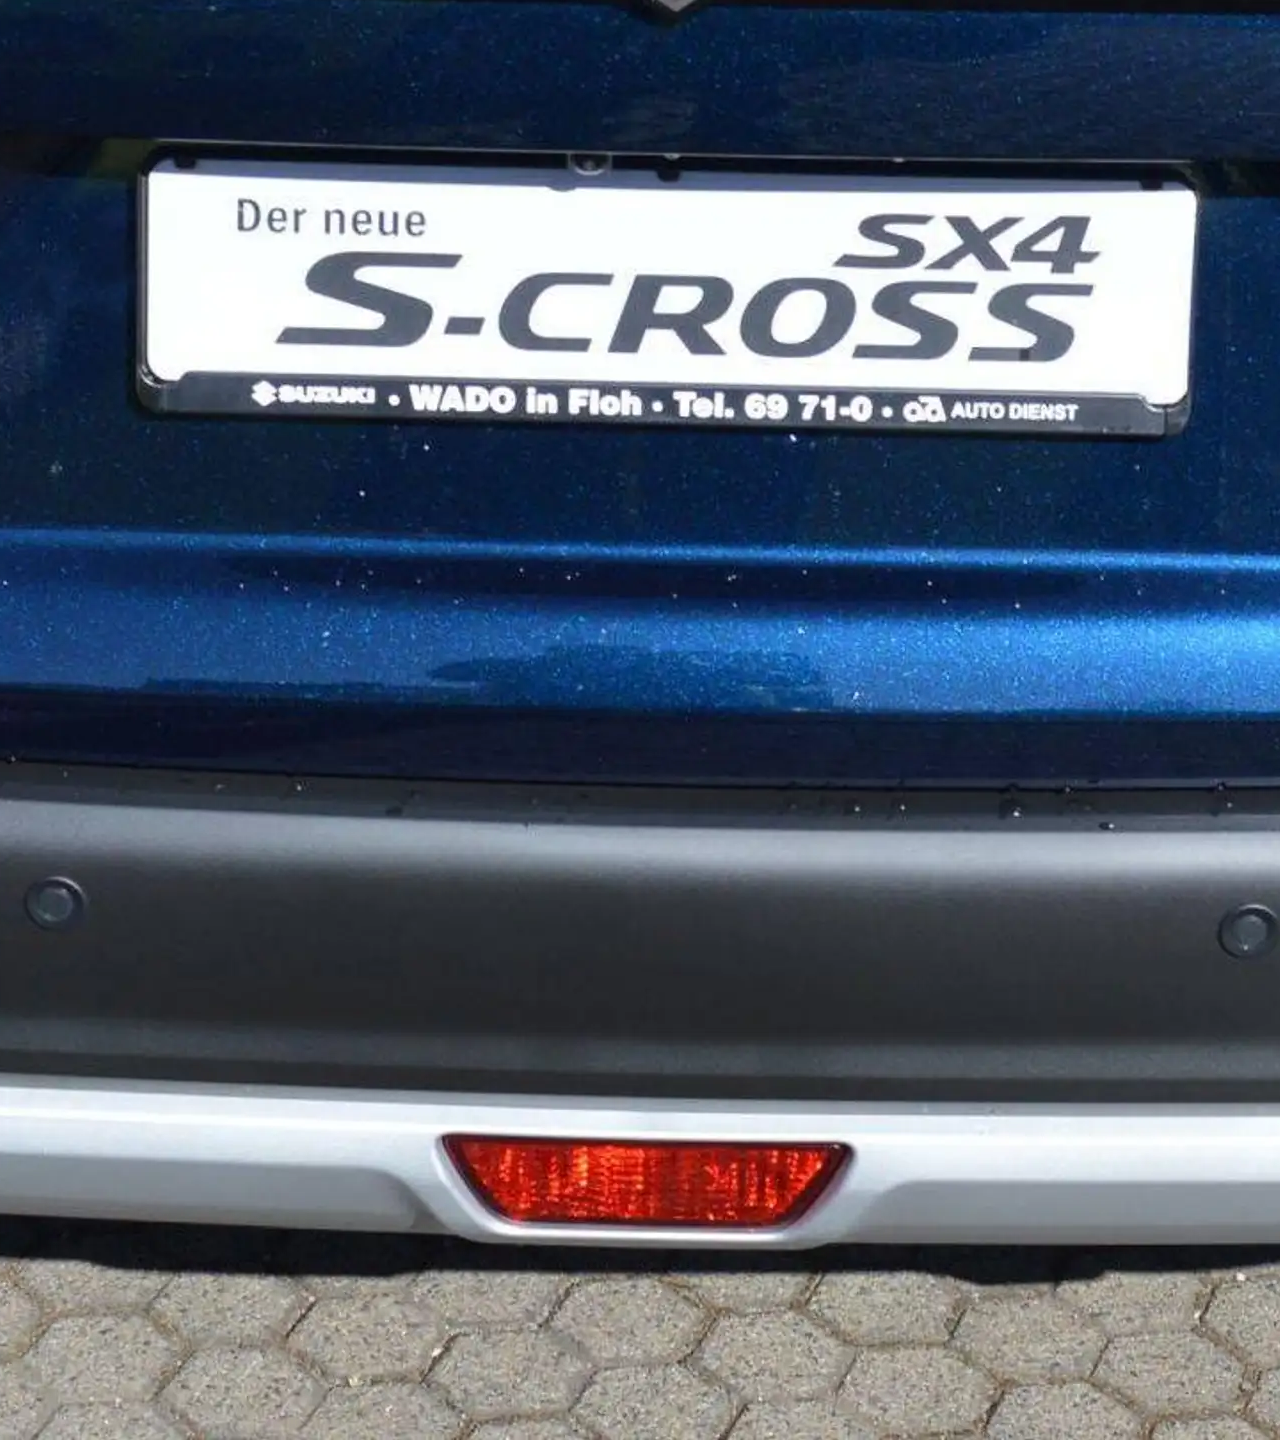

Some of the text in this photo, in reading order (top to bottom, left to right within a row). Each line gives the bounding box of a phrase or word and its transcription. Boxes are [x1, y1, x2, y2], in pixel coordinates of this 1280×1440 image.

[236, 198, 427, 237] Der neue
[833, 213, 1101, 274] SX4
[276, 250, 1095, 362] S-CROSS
[278, 384, 376, 405] SUZUKI
[409, 384, 516, 414] WADO
[526, 386, 558, 415] in
[568, 389, 643, 417] Floh
[673, 391, 735, 419] Tel.
[744, 392, 789, 420] 69
[798, 395, 873, 423] 71-0
[951, 402, 1005, 421] AUTO
[1008, 402, 1079, 422] DIENST
